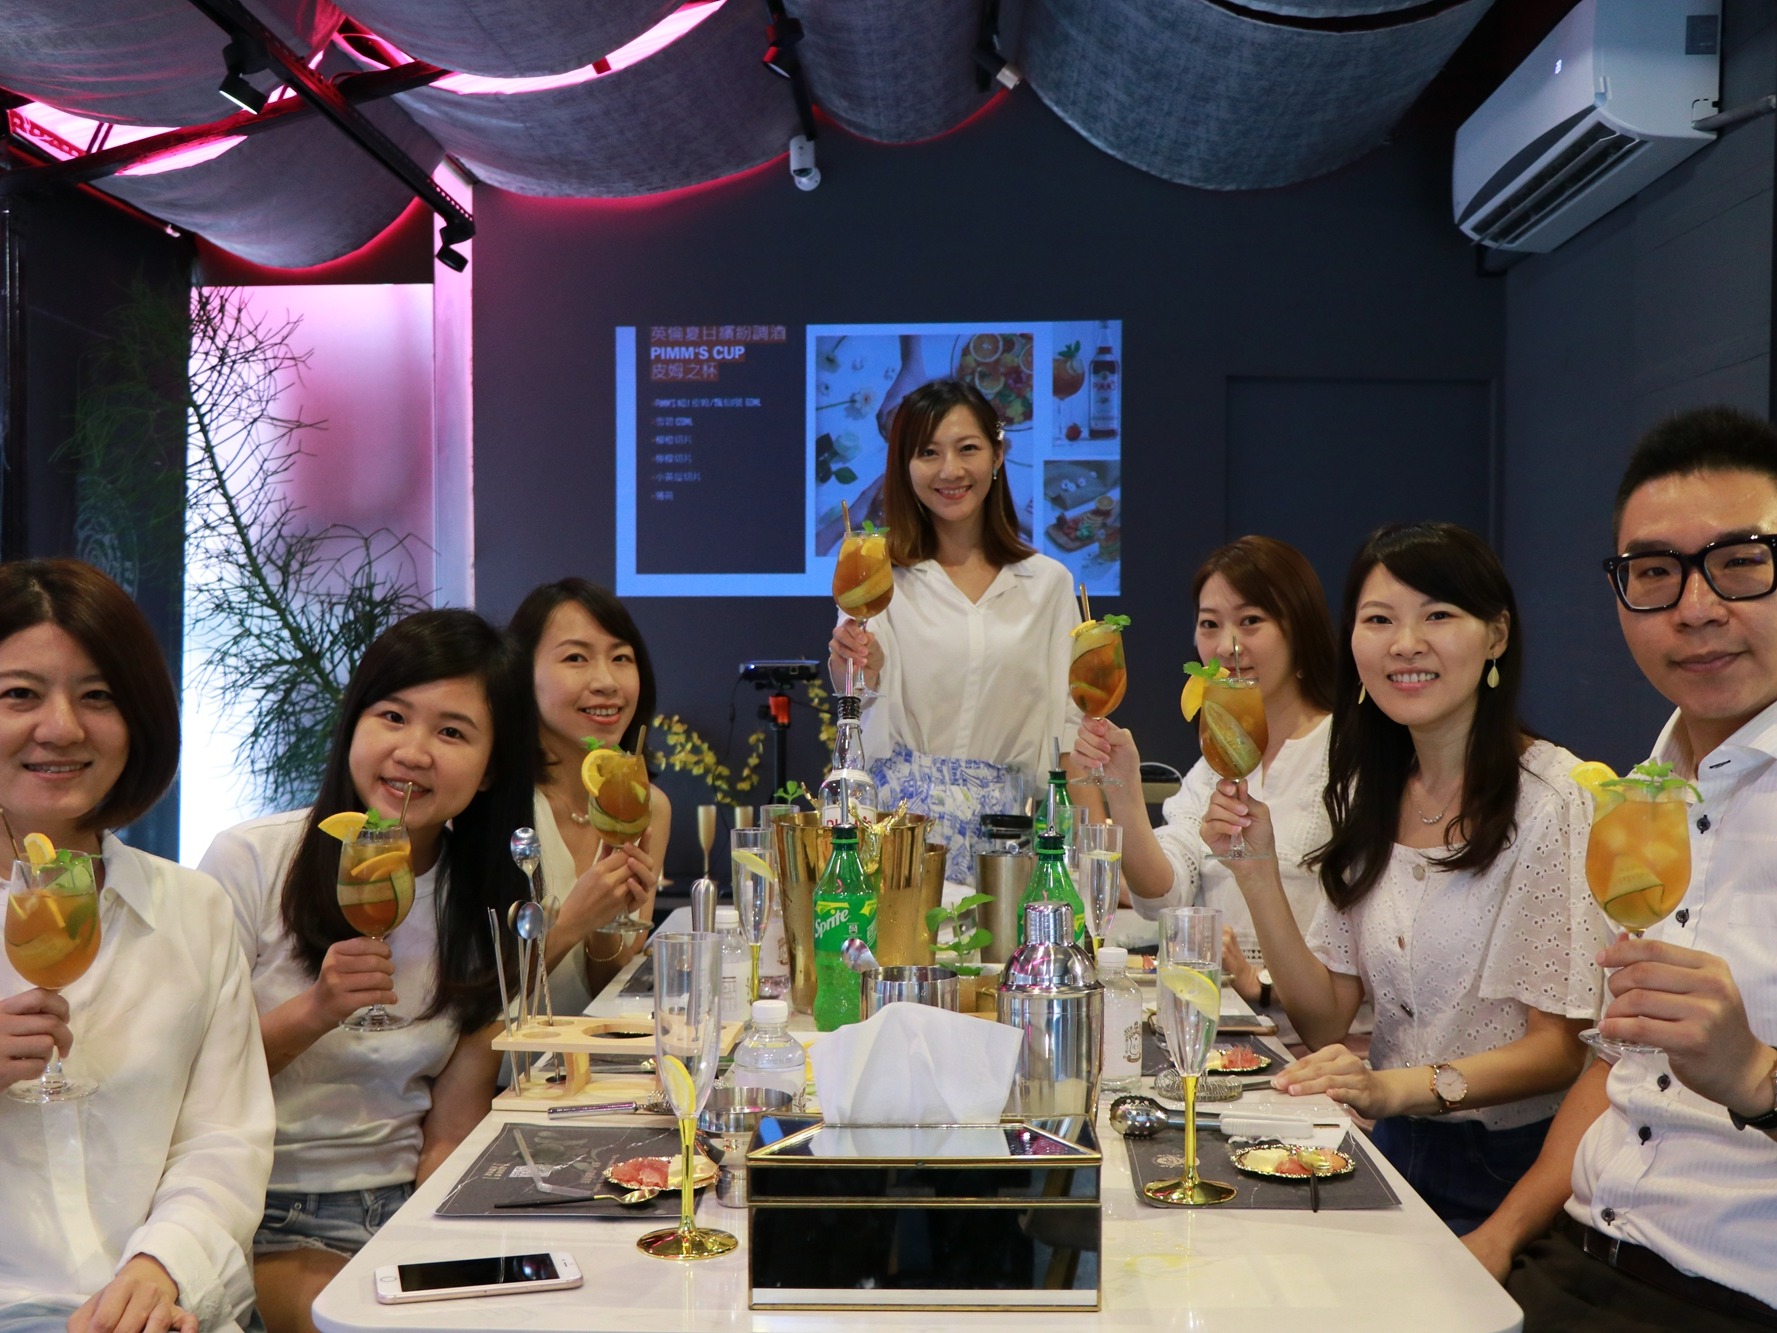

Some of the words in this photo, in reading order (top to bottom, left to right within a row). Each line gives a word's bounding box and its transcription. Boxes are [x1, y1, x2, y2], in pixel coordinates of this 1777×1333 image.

[651, 325, 786, 341] 英倫夏日繽紛調酒
[650, 346, 709, 360] PIMM'S
[712, 346, 745, 360] CUP
[651, 363, 718, 379] 皮姆之杯
[814, 909, 850, 939] Sprite
